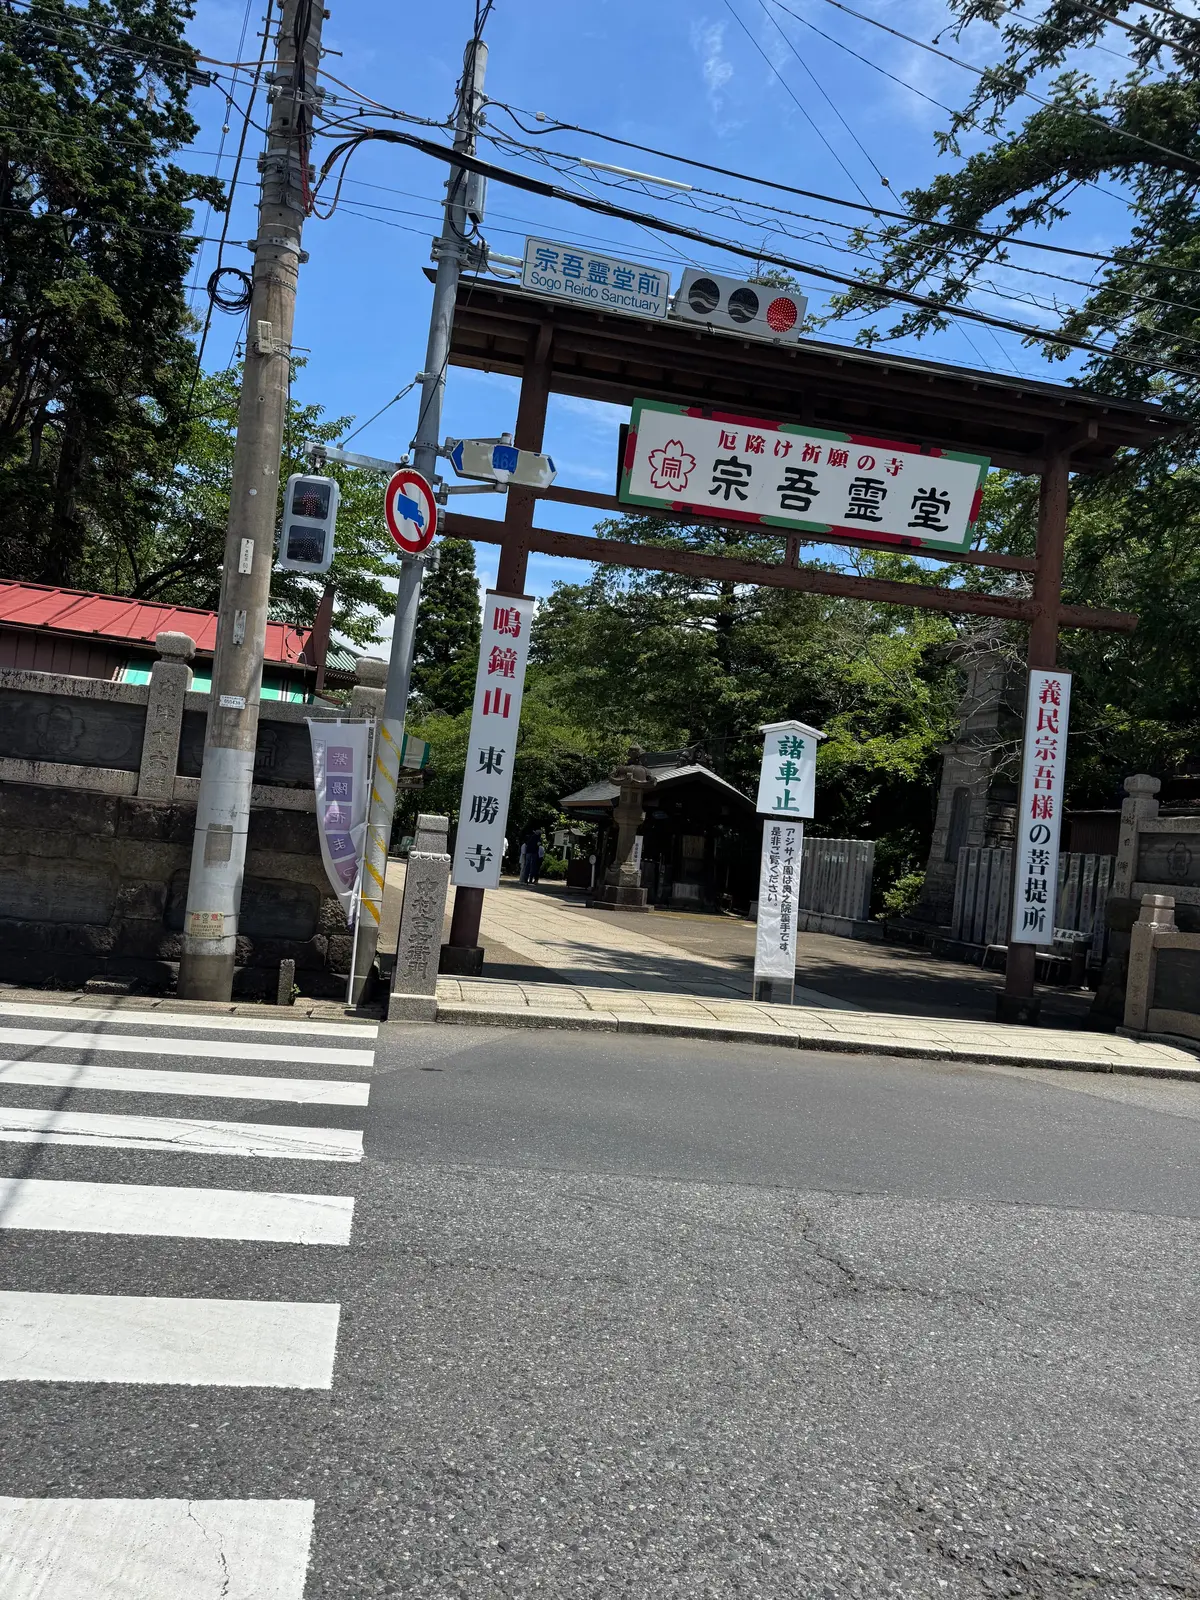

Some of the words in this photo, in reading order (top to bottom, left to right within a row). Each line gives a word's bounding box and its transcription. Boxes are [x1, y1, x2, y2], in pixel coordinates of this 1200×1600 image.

[530, 271, 561, 291] Sogo
[564, 281, 598, 299] Reido
[601, 289, 660, 315] Sanctuary
[535, 247, 661, 298] 宗吾霊堂前
[717, 429, 904, 477] 厄除け祈願の寺
[708, 455, 950, 533] 宗吾霊堂
[482, 606, 522, 719] 鳴鐘山
[464, 745, 506, 873] 東勝寺
[771, 735, 805, 813] 諸車止
[1021, 679, 1062, 933] 義民宗吾様の菩提所
[767, 826, 781, 907] 是非ご覧ください。
